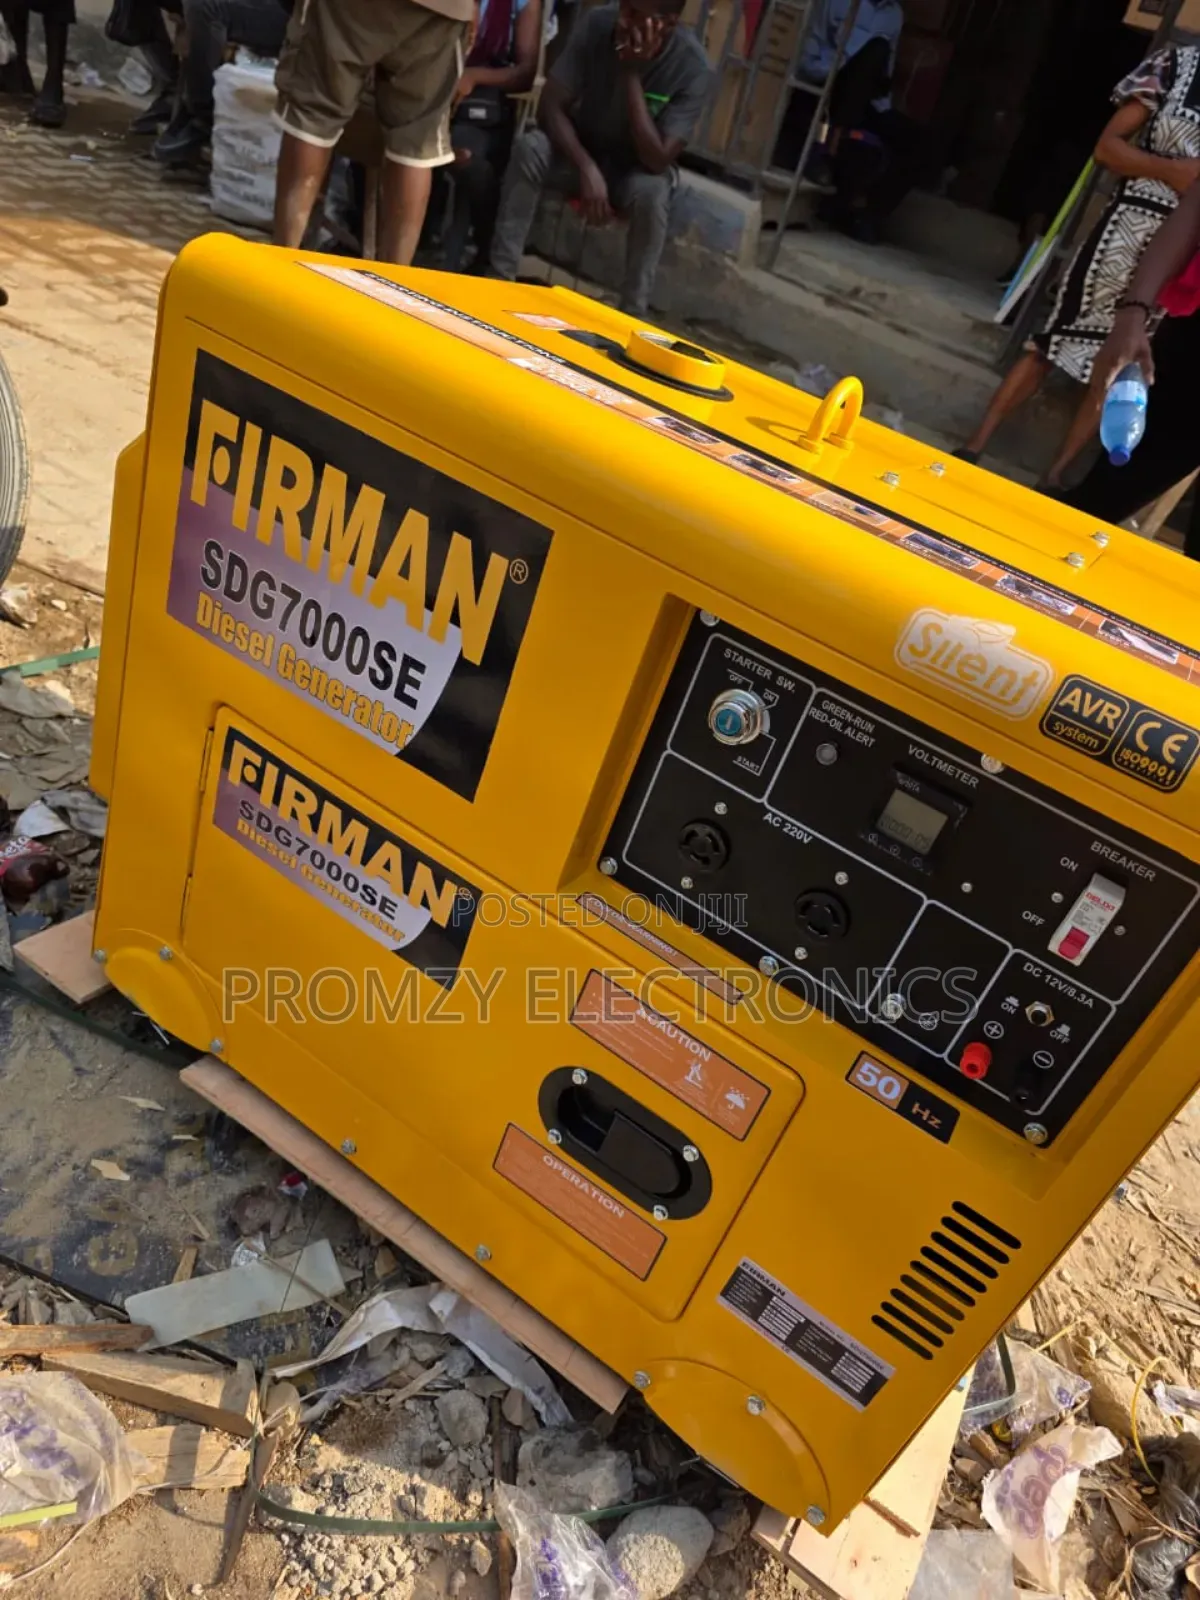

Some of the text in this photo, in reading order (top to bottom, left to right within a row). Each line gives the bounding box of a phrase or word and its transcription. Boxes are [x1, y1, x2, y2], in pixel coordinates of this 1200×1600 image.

[190, 398, 509, 667] FIRMAN
[200, 538, 427, 711] SDG7000SE
[196, 590, 415, 750] Diesel Generator
[723, 648, 796, 694] STARTER SW.
[729, 674, 743, 685] OFF
[907, 622, 1040, 705] Silent
[762, 692, 775, 702] ON
[821, 700, 876, 733] GREEN-RUN
[1058, 687, 1122, 730] AVR
[808, 706, 876, 748] RED-OIL ALERT
[1053, 721, 1100, 749] system
[1136, 721, 1189, 765] CE
[736, 755, 760, 772] START
[908, 744, 980, 789] VOLTMETER
[1120, 747, 1176, 781] ISO9001
[228, 739, 458, 929] FIRMAN
[763, 811, 813, 845] AC 220V
[238, 799, 398, 921] SDG7000SE
[1060, 856, 1079, 872] ON
[1090, 840, 1157, 882] BREAKER
[1022, 910, 1045, 928] OFF
[1023, 961, 1094, 1009] DC 12V/8.3A
[1001, 1001, 1017, 1015] ON
[647, 1013, 712, 1062] CAUTION
[1050, 1028, 1070, 1045] OFF
[857, 1061, 942, 1130] 50 Hz
[543, 1154, 625, 1219] OPERATION
